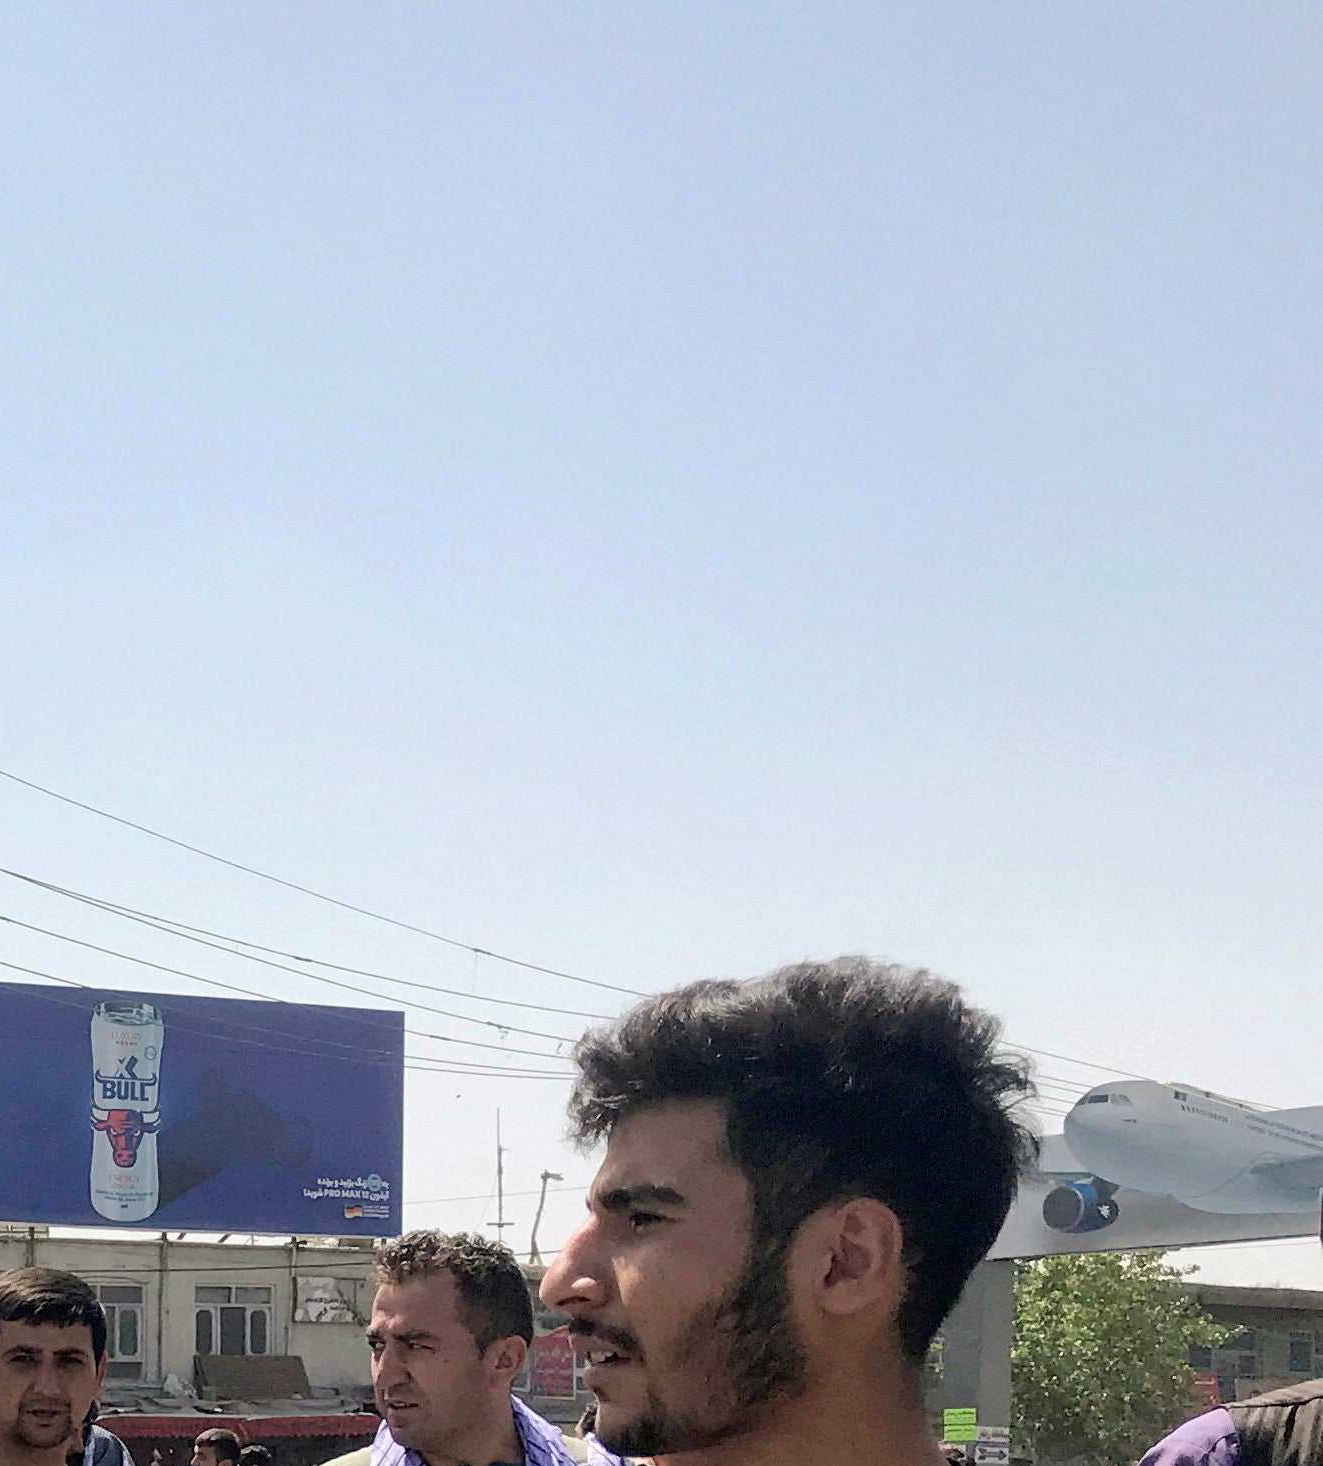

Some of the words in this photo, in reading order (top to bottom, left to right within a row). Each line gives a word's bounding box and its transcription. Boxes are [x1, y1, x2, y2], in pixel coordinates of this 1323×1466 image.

[98, 1076, 154, 1102] BULL
[324, 1189, 341, 1198] PRO
[342, 1190, 361, 1199] MAX
